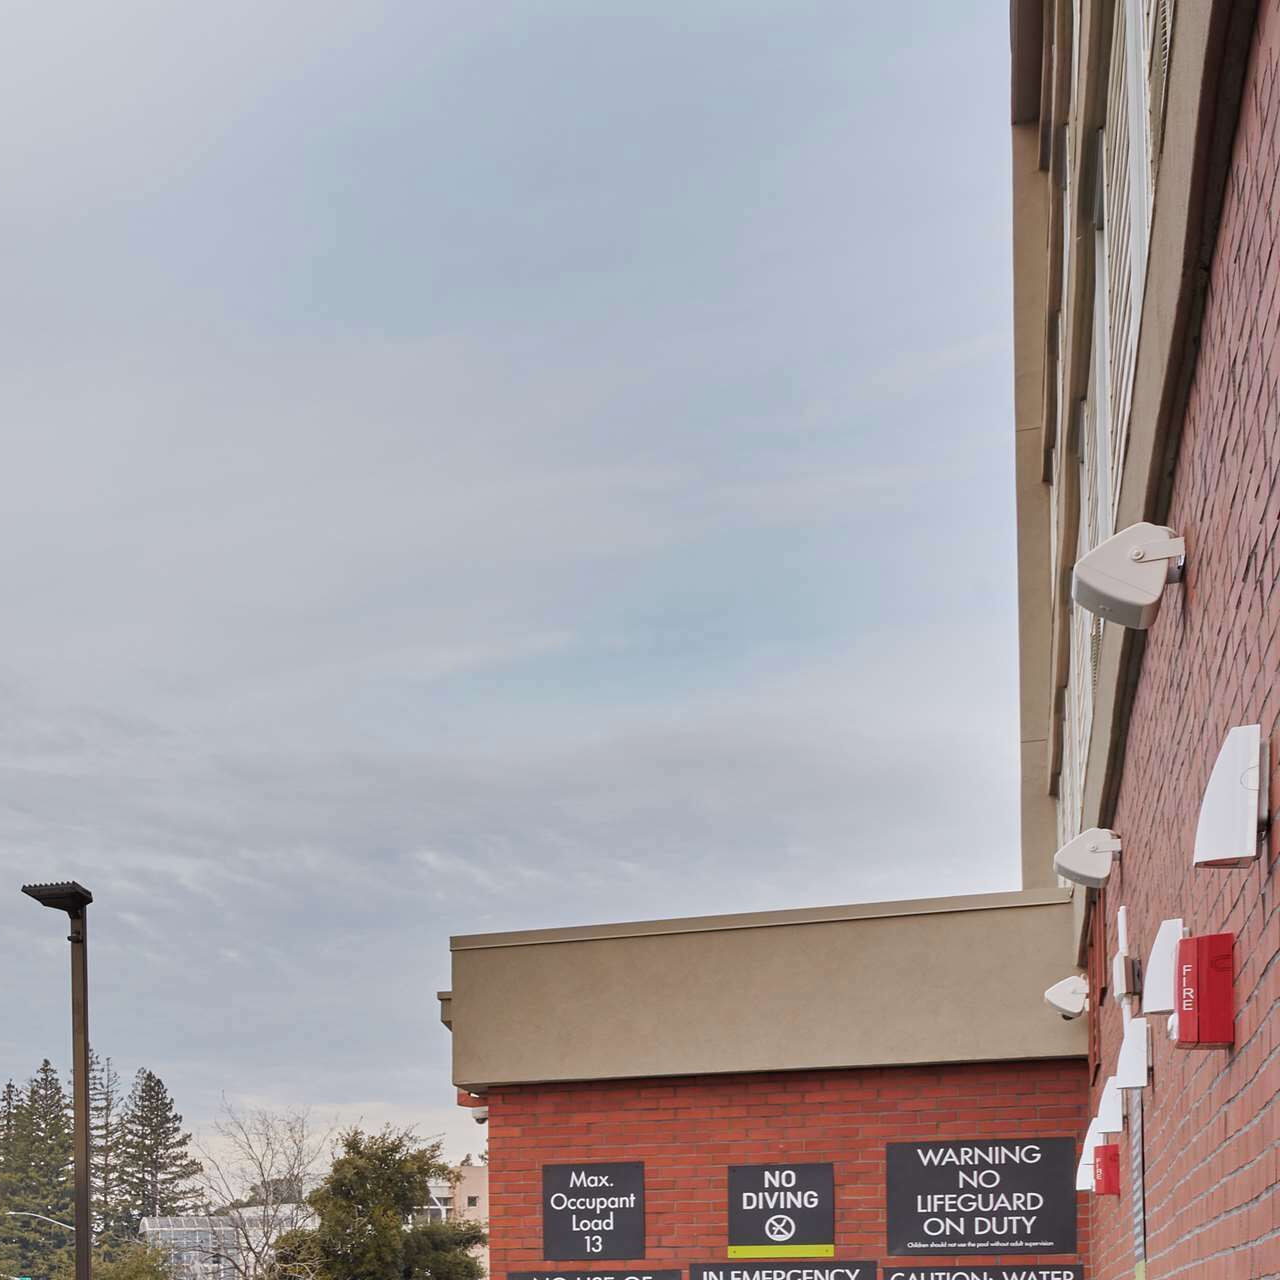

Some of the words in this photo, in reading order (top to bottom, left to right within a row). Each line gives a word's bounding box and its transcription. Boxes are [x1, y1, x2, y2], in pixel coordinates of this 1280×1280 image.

[1182, 964, 1194, 1011] FIRE
[917, 1144, 1042, 1167] WARNING
[569, 1170, 614, 1188] Max.
[764, 1170, 796, 1188] NO
[958, 1169, 1001, 1189] NO
[550, 1193, 636, 1214] Occupant
[742, 1191, 819, 1210] DIVING
[917, 1192, 1044, 1213] LIFEGUARD
[572, 1211, 614, 1231] Load
[923, 1217, 965, 1236] ON
[974, 1215, 1037, 1235] DUTY
[584, 1235, 603, 1253] 13
